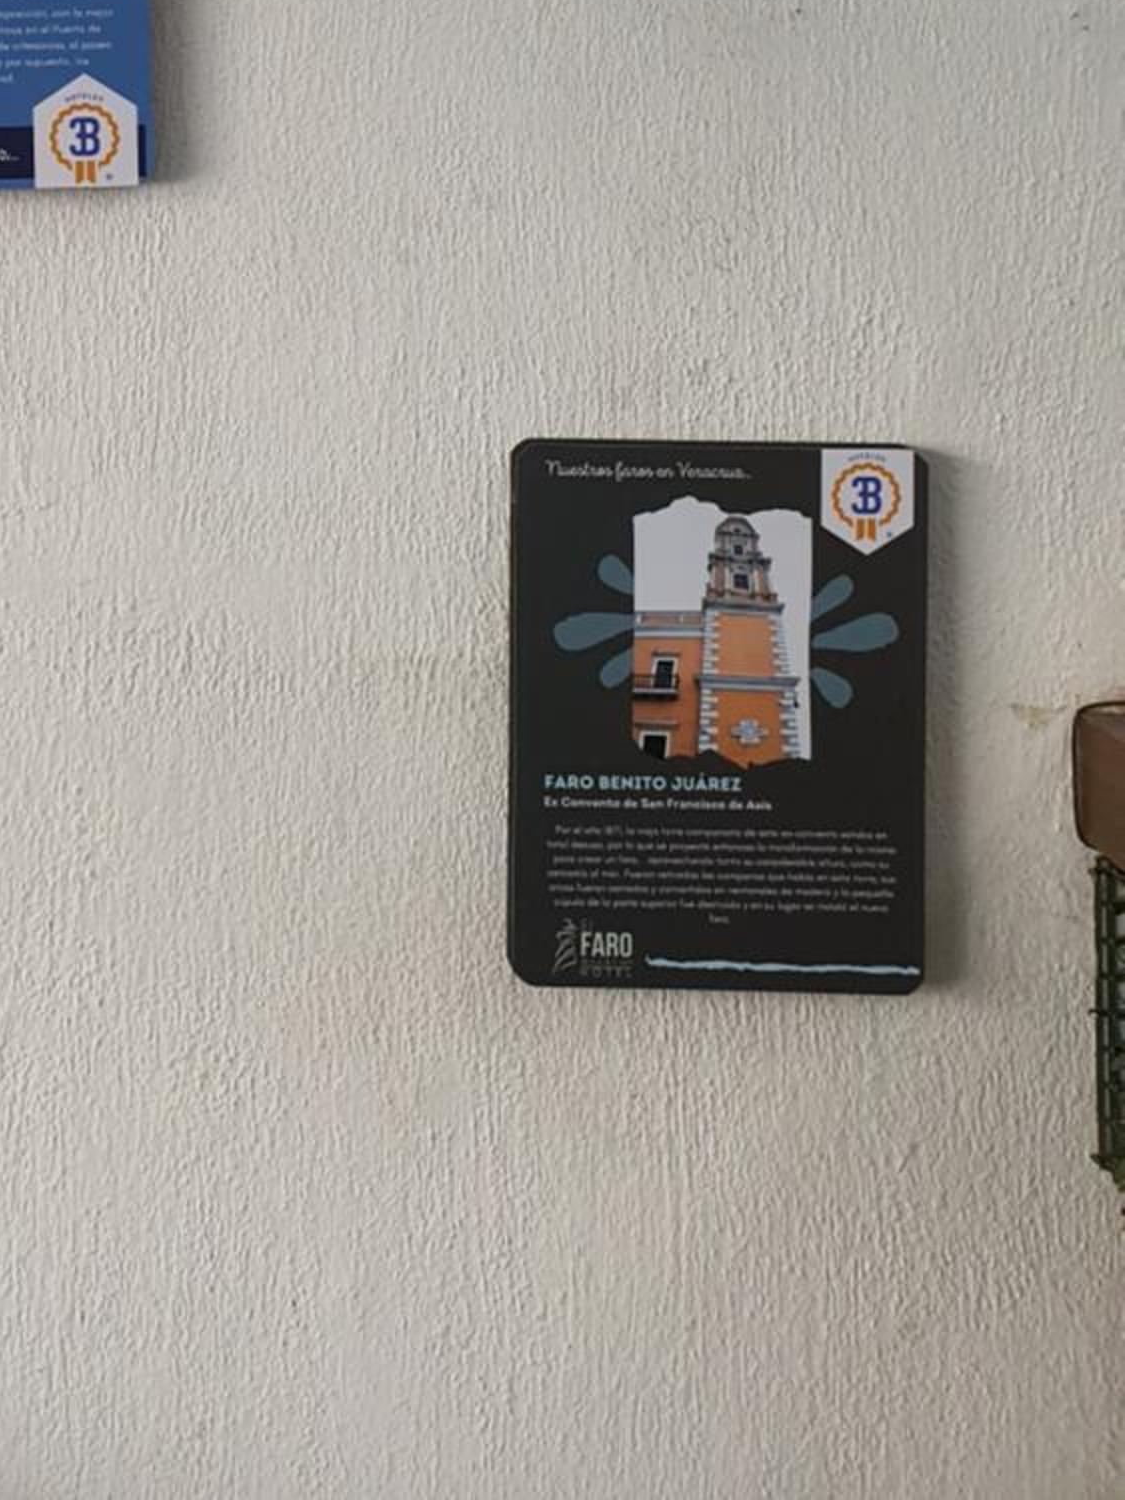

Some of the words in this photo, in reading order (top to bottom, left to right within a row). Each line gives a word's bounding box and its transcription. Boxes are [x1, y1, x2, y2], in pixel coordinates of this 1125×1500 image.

[614, 460, 654, 483] faros
[655, 465, 674, 479] en
[543, 774, 595, 790] FARO
[598, 775, 667, 791] BENITO
[671, 771, 743, 792] JUÁREZ
[623, 797, 638, 809] de
[640, 797, 665, 810] San
[580, 930, 634, 957] FARO
